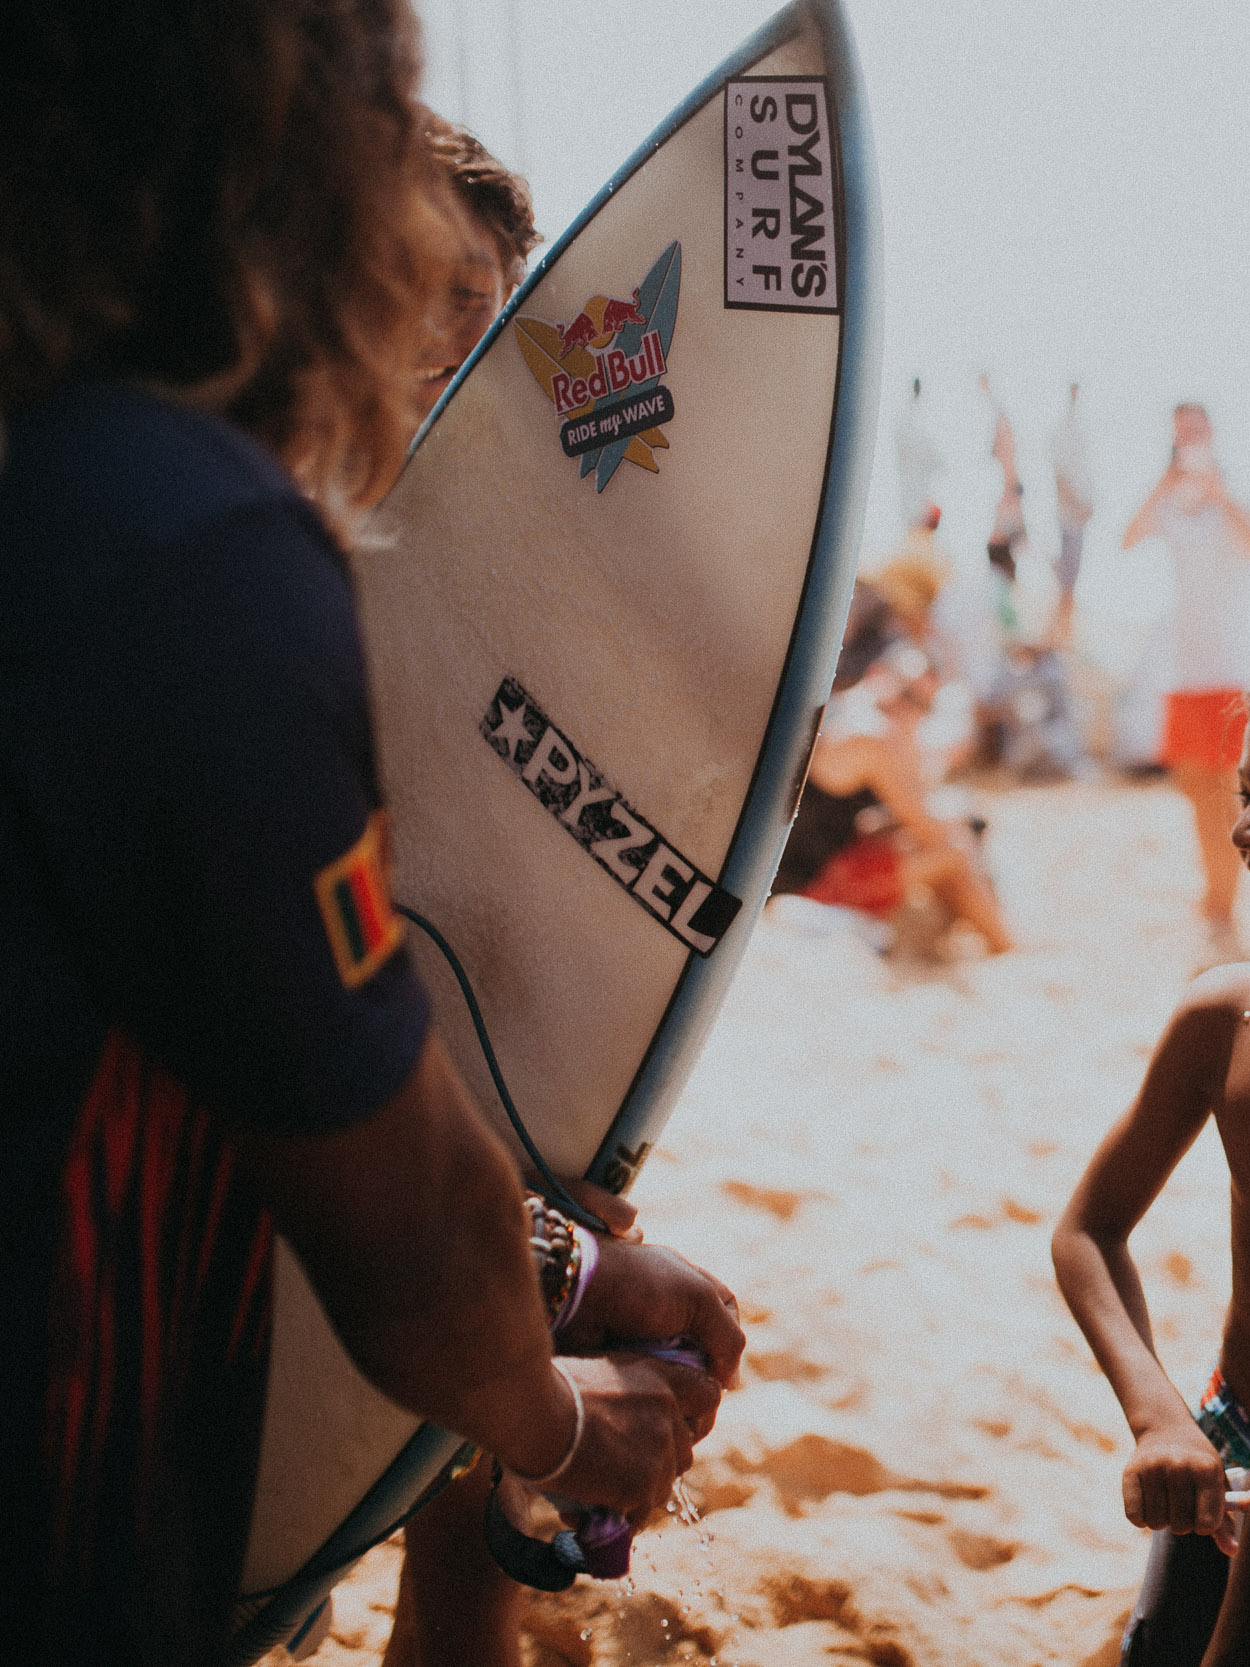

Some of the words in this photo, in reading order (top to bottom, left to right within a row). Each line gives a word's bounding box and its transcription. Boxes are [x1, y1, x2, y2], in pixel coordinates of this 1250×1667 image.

[734, 94, 745, 287] COMPANY
[750, 94, 782, 292] SURF
[551, 352, 609, 413] Red
[607, 332, 666, 392] Bull
[567, 421, 598, 447] RIDE
[600, 414, 623, 436] my
[622, 394, 666, 427] WAVE
[521, 725, 717, 954] PYZEL
